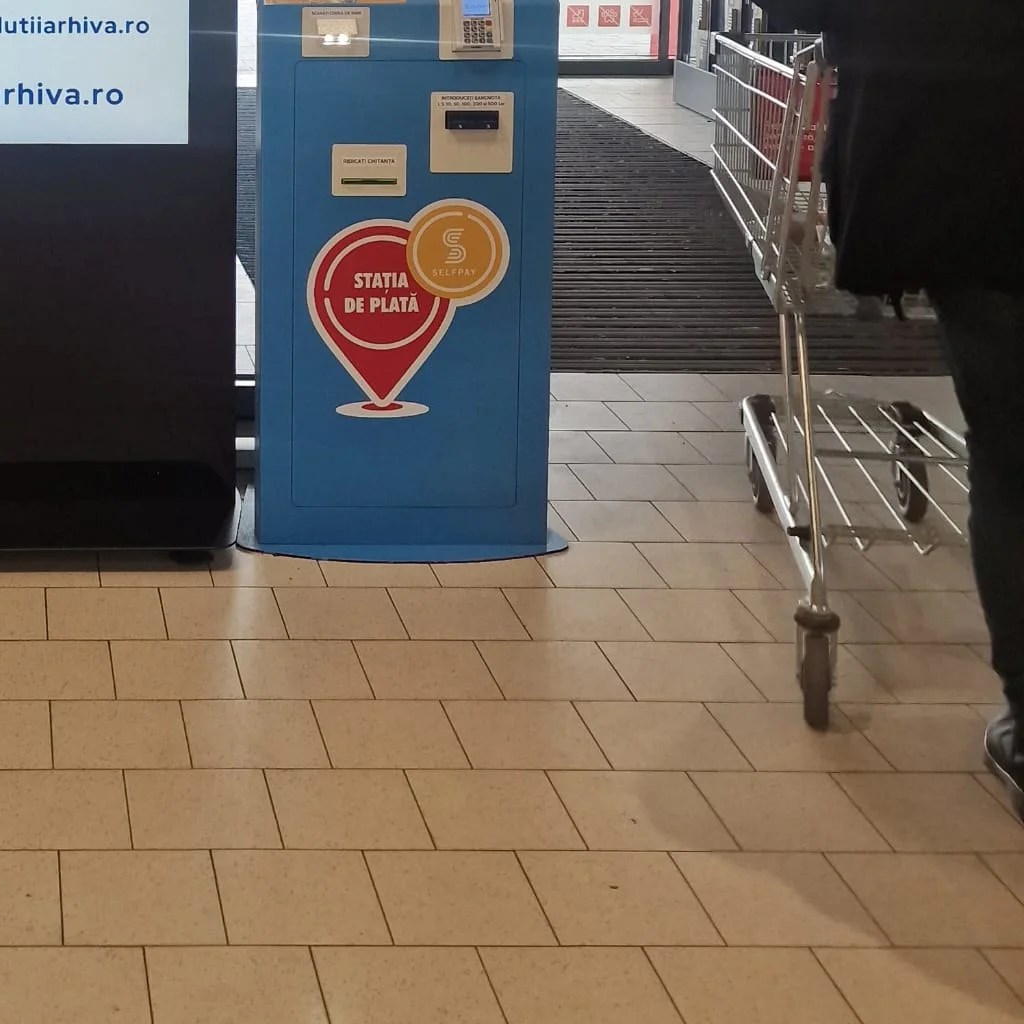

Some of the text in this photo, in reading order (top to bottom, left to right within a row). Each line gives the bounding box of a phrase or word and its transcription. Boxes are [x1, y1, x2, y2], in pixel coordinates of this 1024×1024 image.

[353, 271, 409, 294] STAȚIA
[432, 268, 476, 277] SELFPAY
[344, 292, 420, 314] DE PLATĂ
